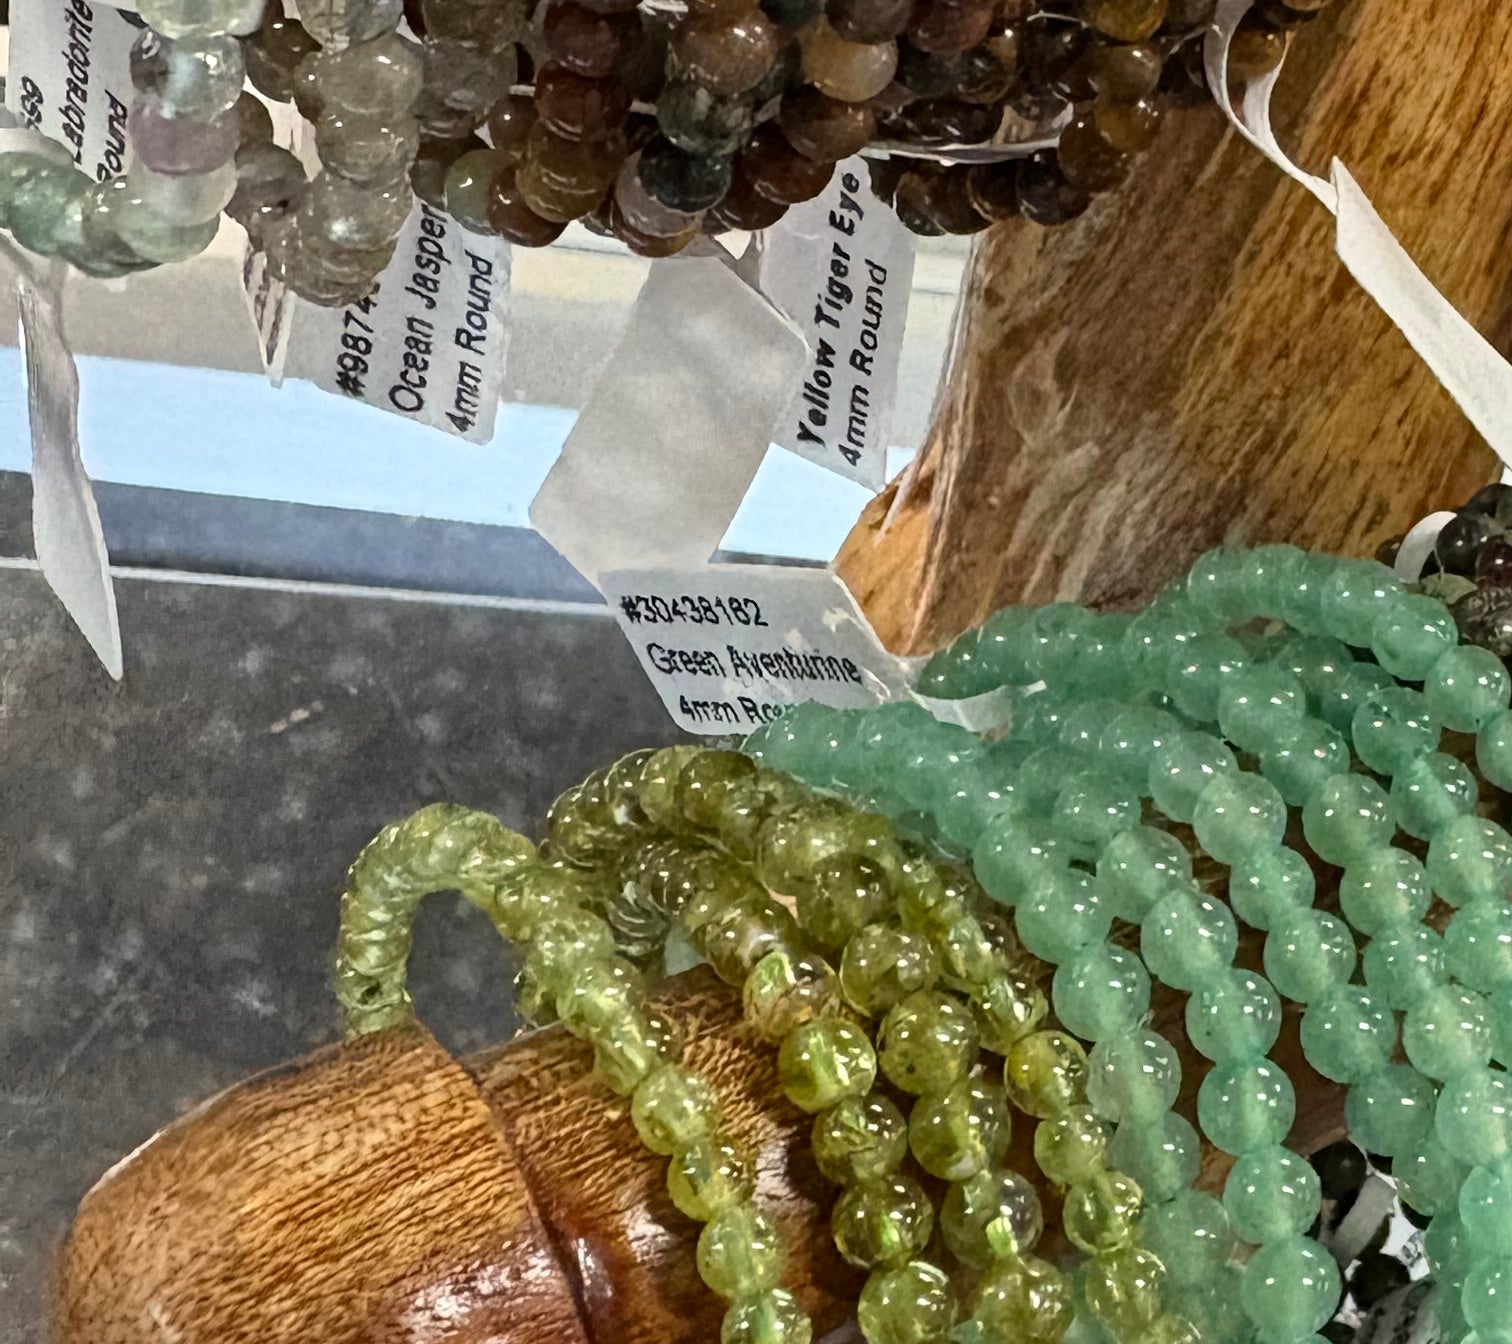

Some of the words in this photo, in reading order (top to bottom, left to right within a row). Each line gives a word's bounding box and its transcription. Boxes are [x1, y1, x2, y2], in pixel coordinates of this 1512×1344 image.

[828, 170, 862, 235] Eye
[404, 201, 455, 312] Jasper
[454, 250, 494, 357] Round
[815, 244, 857, 339] Tiger
[334, 282, 381, 399] #9874
[388, 313, 436, 413] Ocean
[848, 260, 888, 374] Round
[445, 360, 483, 433] 4mm
[794, 343, 837, 447] Yellow
[836, 390, 872, 466] 4mm
[646, 642, 722, 678] Green
[726, 643, 863, 685] Aventurine
[678, 695, 739, 723] 4mm
